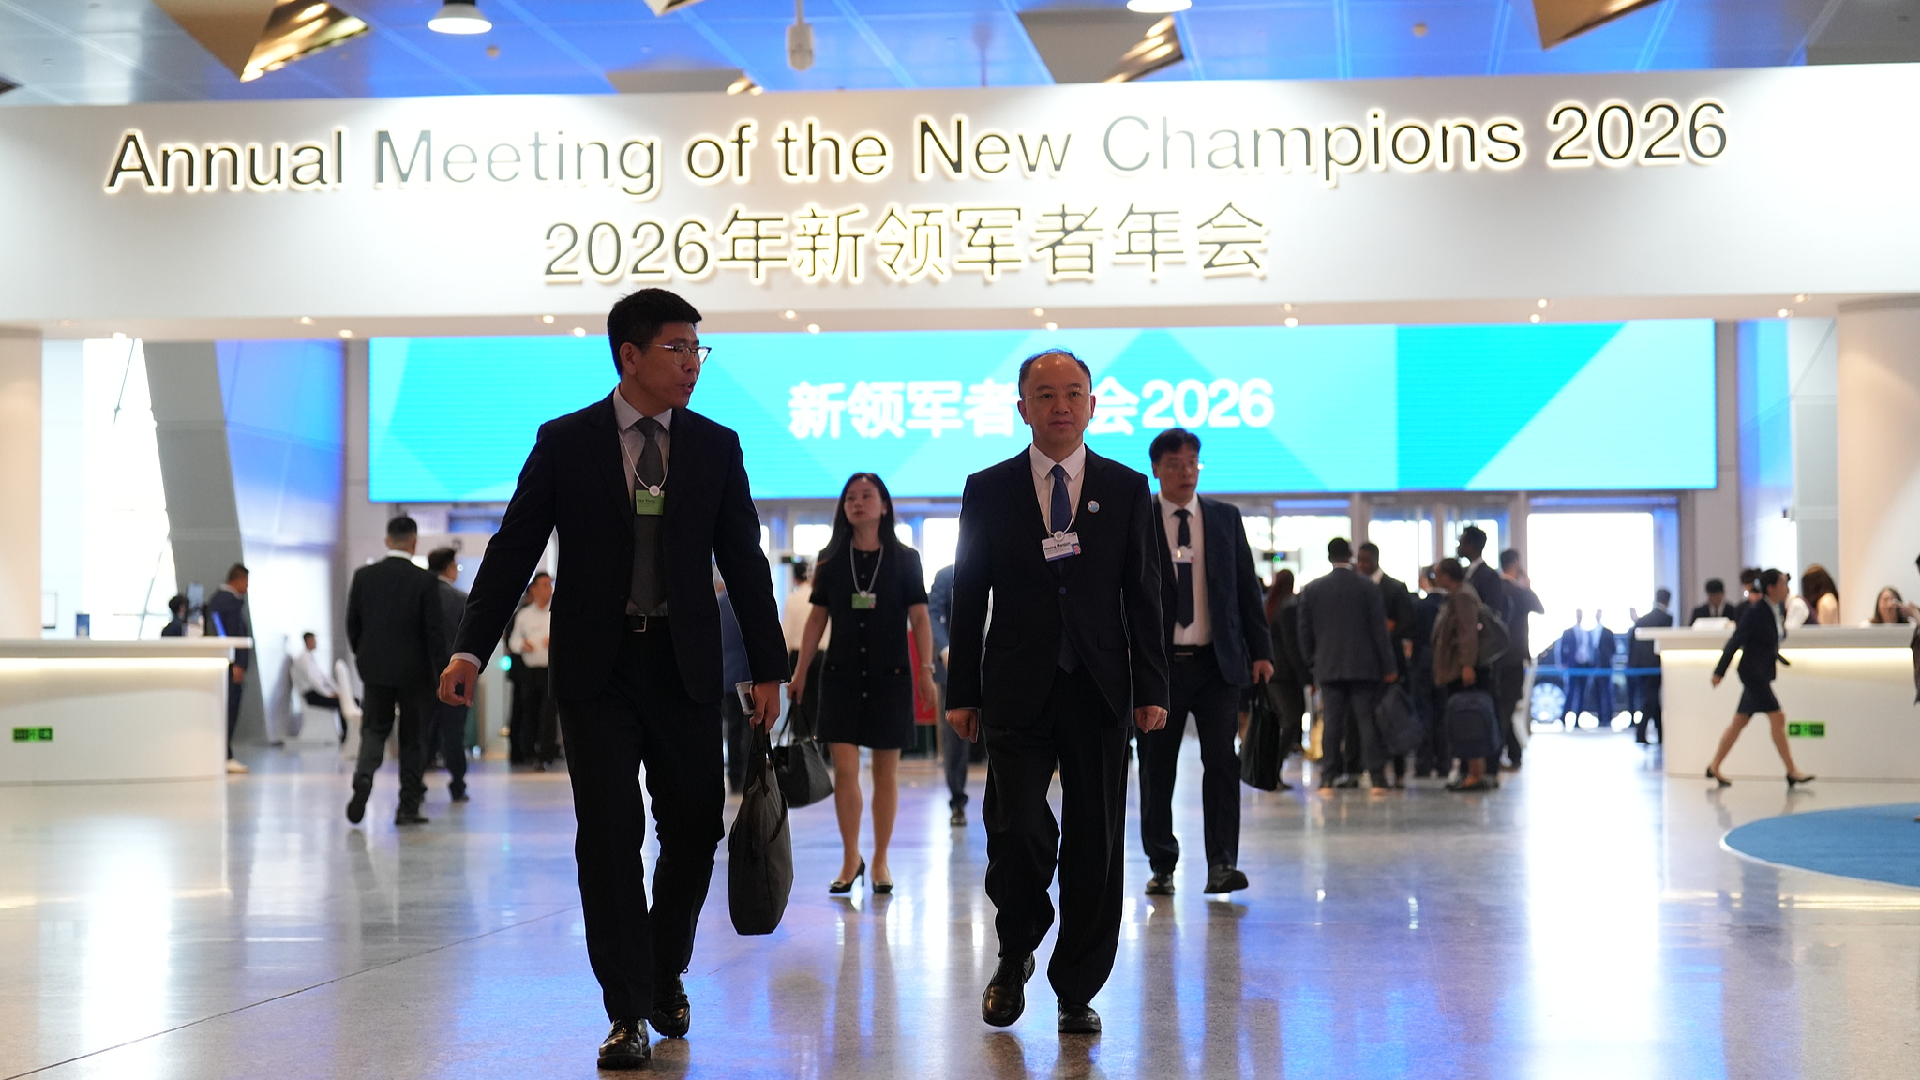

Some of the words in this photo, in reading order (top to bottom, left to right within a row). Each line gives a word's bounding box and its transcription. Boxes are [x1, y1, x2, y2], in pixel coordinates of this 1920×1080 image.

[104, 129, 344, 190] Annual
[375, 129, 656, 197] Meeting
[685, 123, 753, 180] of
[776, 122, 888, 178] the
[919, 119, 1073, 176] New
[1101, 112, 1522, 182] Champions
[1550, 101, 1728, 163] 2026
[543, 201, 1269, 281] 2026年新领军者年会
[787, 377, 1276, 439] 新领军者会2026
